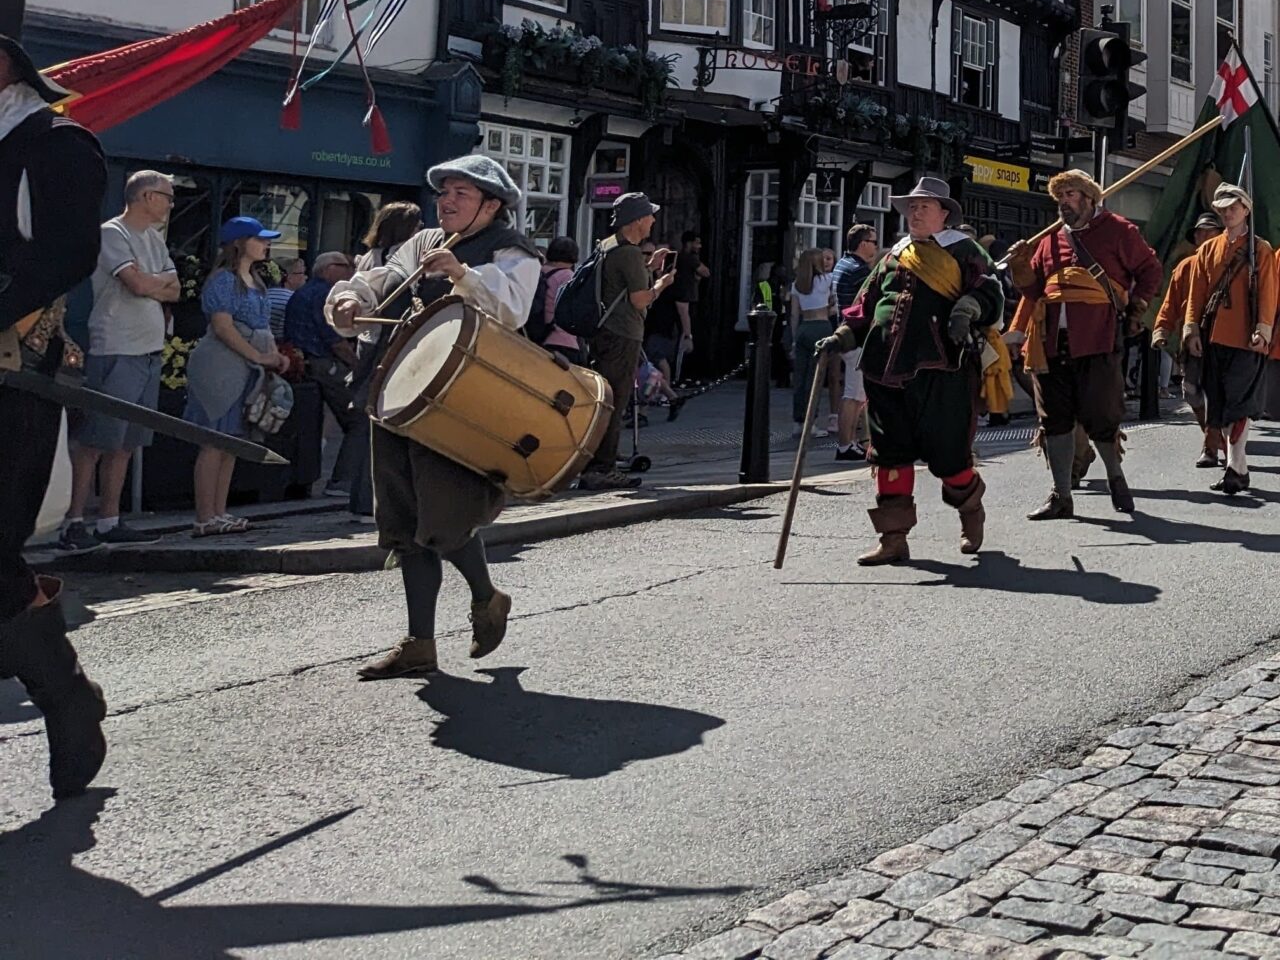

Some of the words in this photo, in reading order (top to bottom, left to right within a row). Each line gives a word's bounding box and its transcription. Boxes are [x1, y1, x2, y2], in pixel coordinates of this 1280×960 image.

[311, 150, 391, 168] robertdyas.co.uk
[971, 163, 993, 183] appy
[996, 168, 1020, 186] snaps
